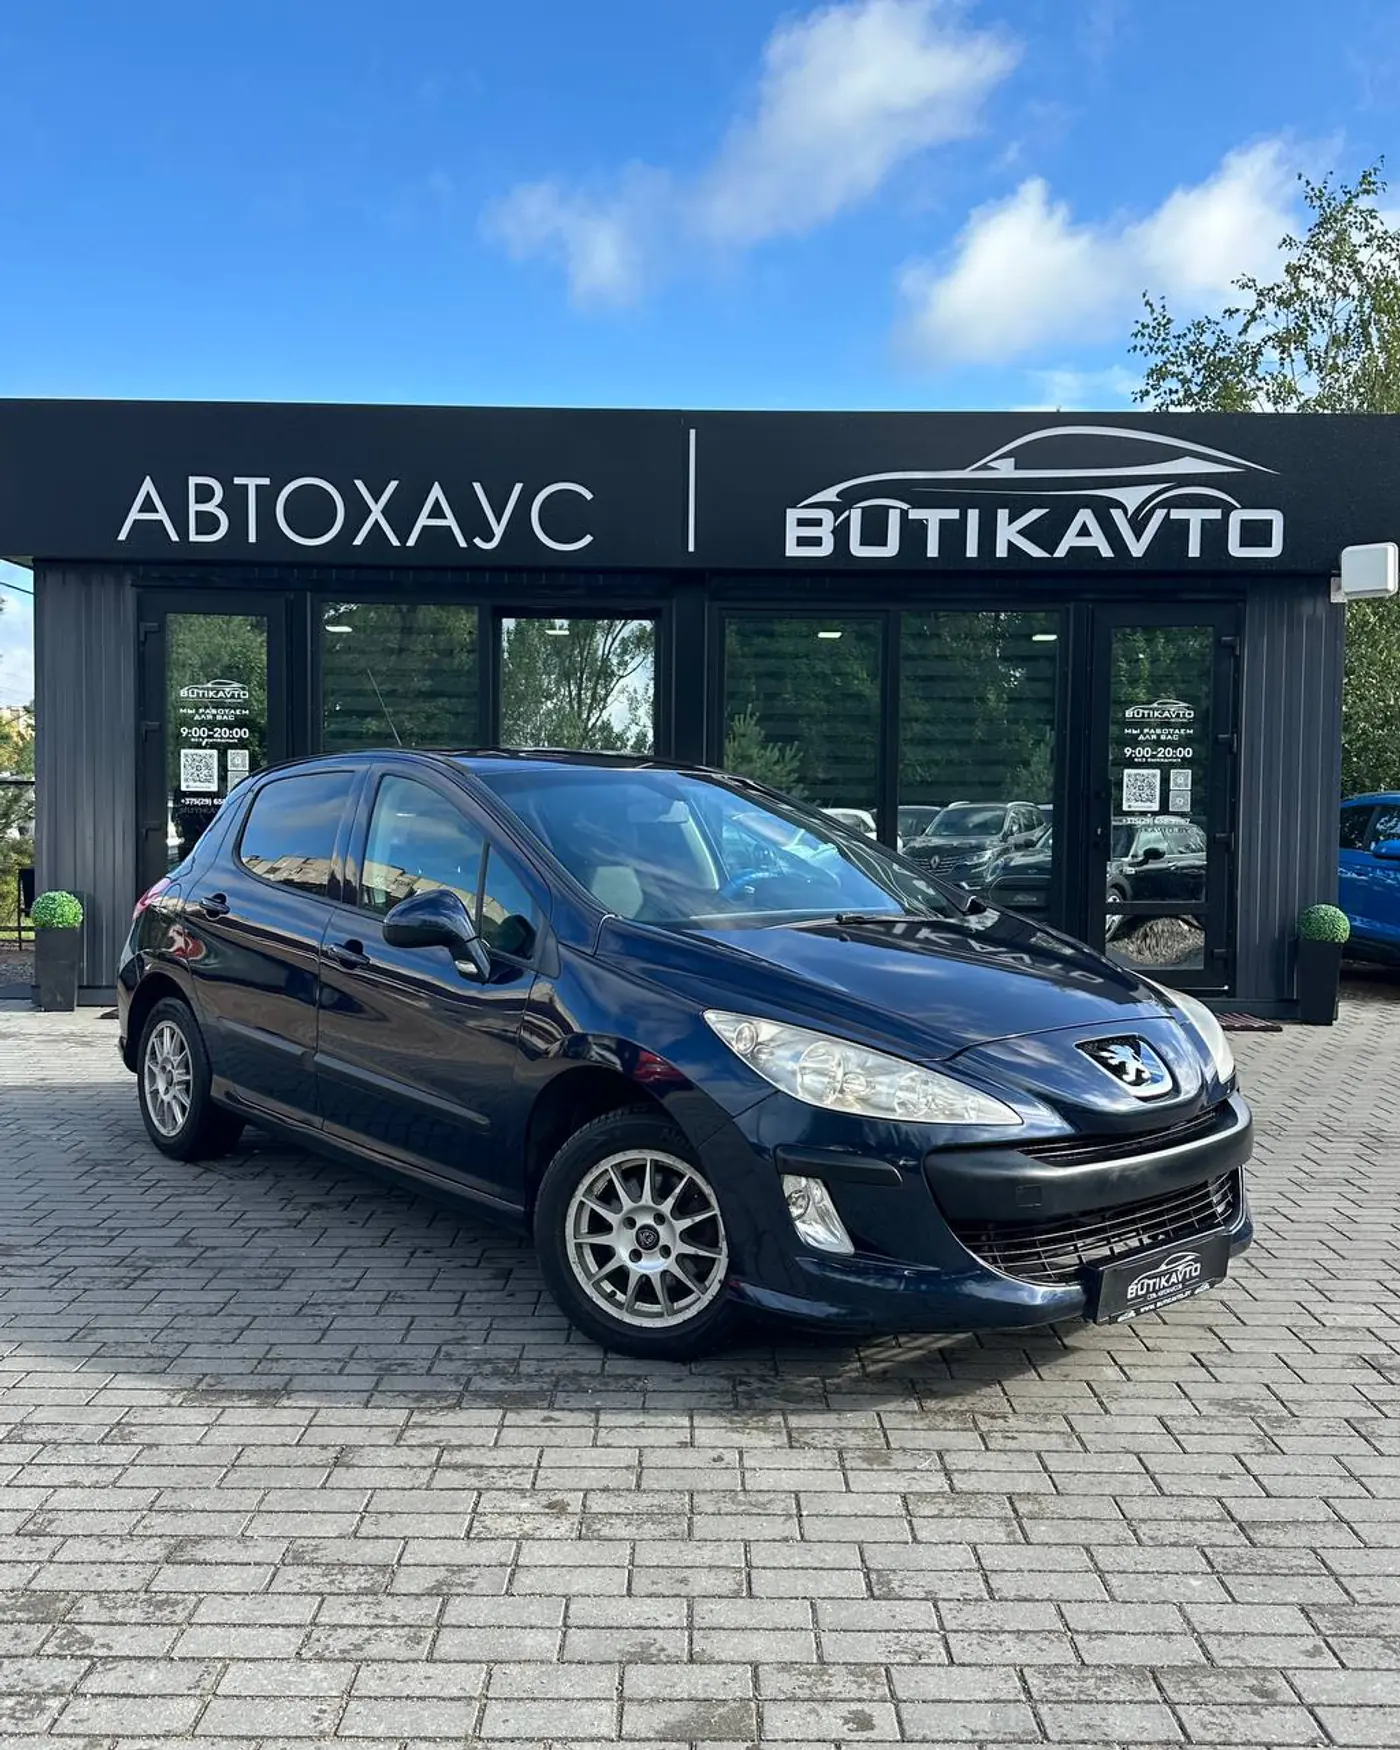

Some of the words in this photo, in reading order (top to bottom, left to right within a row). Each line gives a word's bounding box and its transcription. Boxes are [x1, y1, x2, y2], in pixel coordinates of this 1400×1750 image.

[117, 475, 595, 552] АВТОХАУС
[785, 508, 1284, 558] BUTIKAVTO
[180, 690, 249, 698] BUTIKAVTO
[1125, 710, 1194, 718] BUTIKAVTO
[180, 727, 249, 738] 9:00-20:00
[1124, 747, 1193, 758] 9:00-20:00
[1127, 1263, 1201, 1299] BUTIKAVTO
